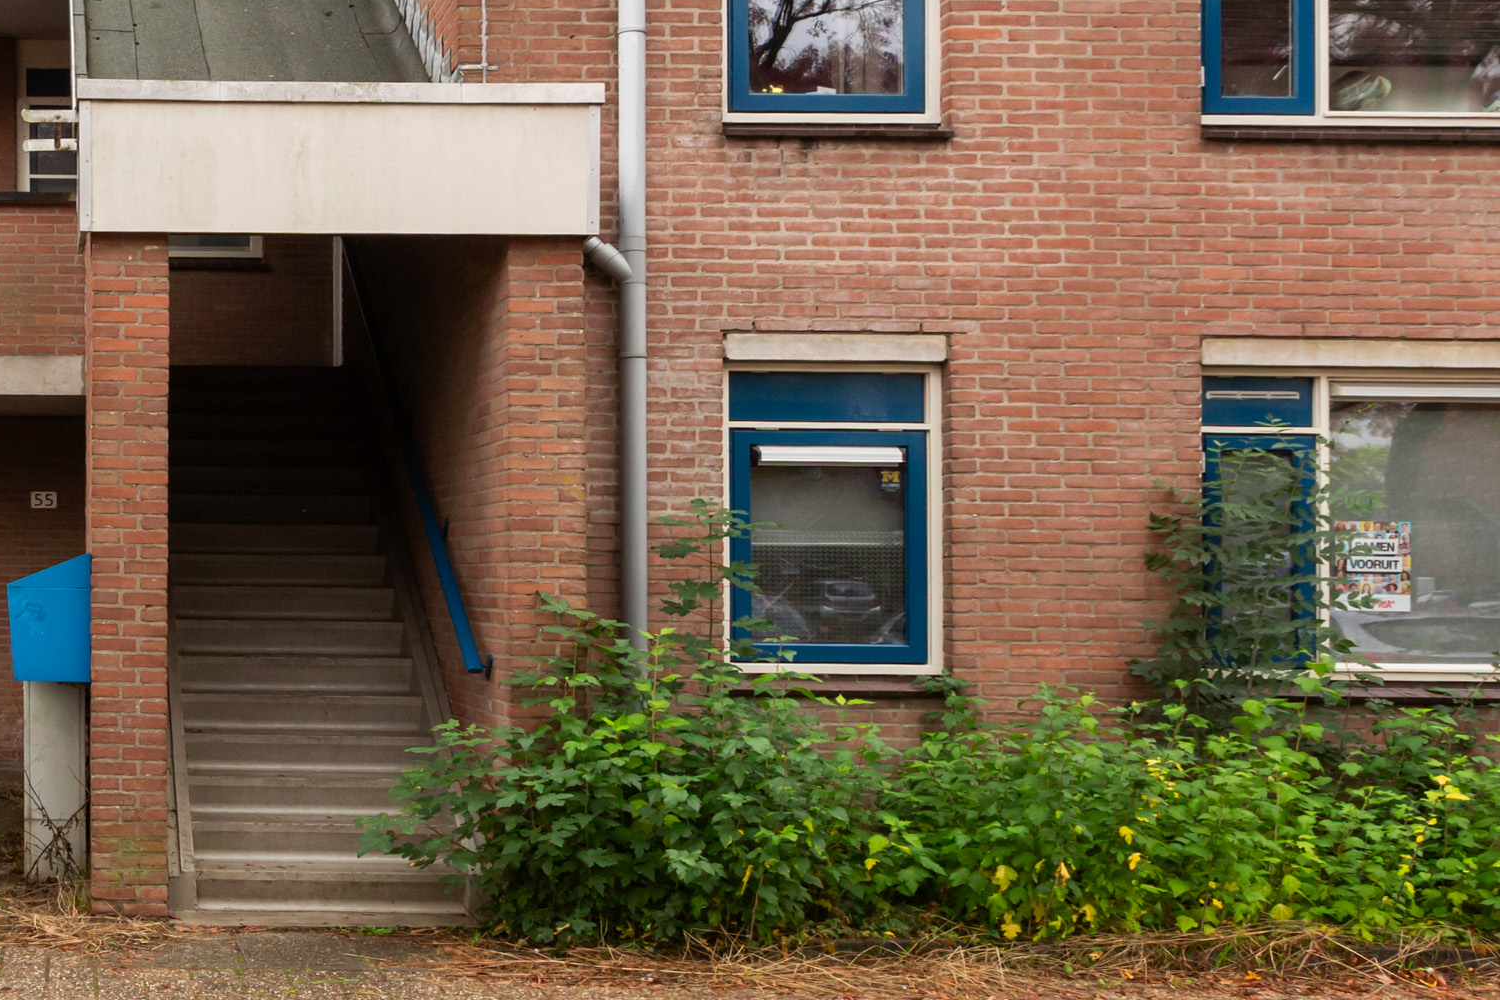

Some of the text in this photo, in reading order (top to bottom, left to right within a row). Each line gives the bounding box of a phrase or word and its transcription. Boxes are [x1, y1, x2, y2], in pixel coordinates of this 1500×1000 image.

[881, 471, 900, 483] M
[34, 493, 54, 507] 55
[1350, 559, 1400, 570] VOORUIT
